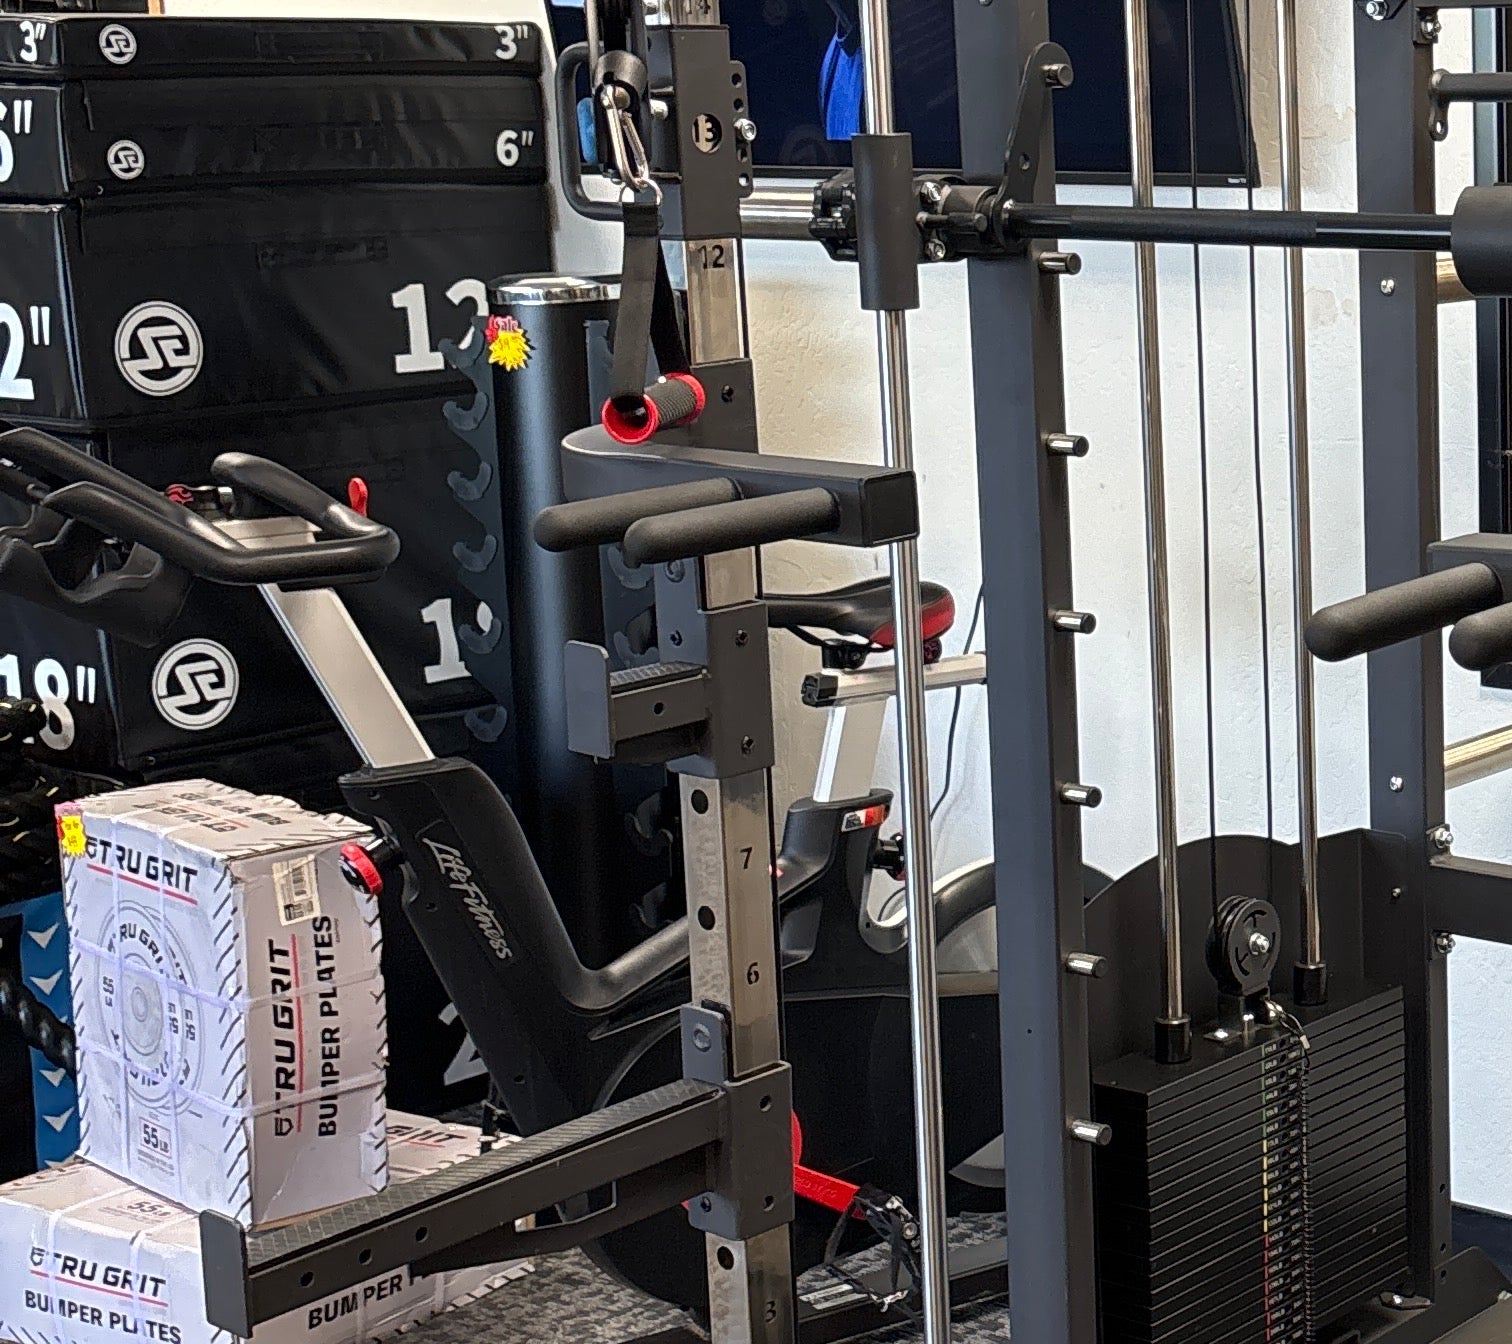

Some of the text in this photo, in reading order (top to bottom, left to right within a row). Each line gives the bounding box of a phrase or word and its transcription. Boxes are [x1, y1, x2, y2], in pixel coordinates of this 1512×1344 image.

[693, 114, 719, 146] 13
[700, 244, 726, 270] 12
[96, 839, 199, 894] TRU GRIT
[740, 846, 753, 870] 7
[268, 938, 295, 1030] GRIT
[746, 962, 760, 986] 6
[307, 1273, 403, 1331] BUMPER
[764, 1300, 778, 1324] 3
